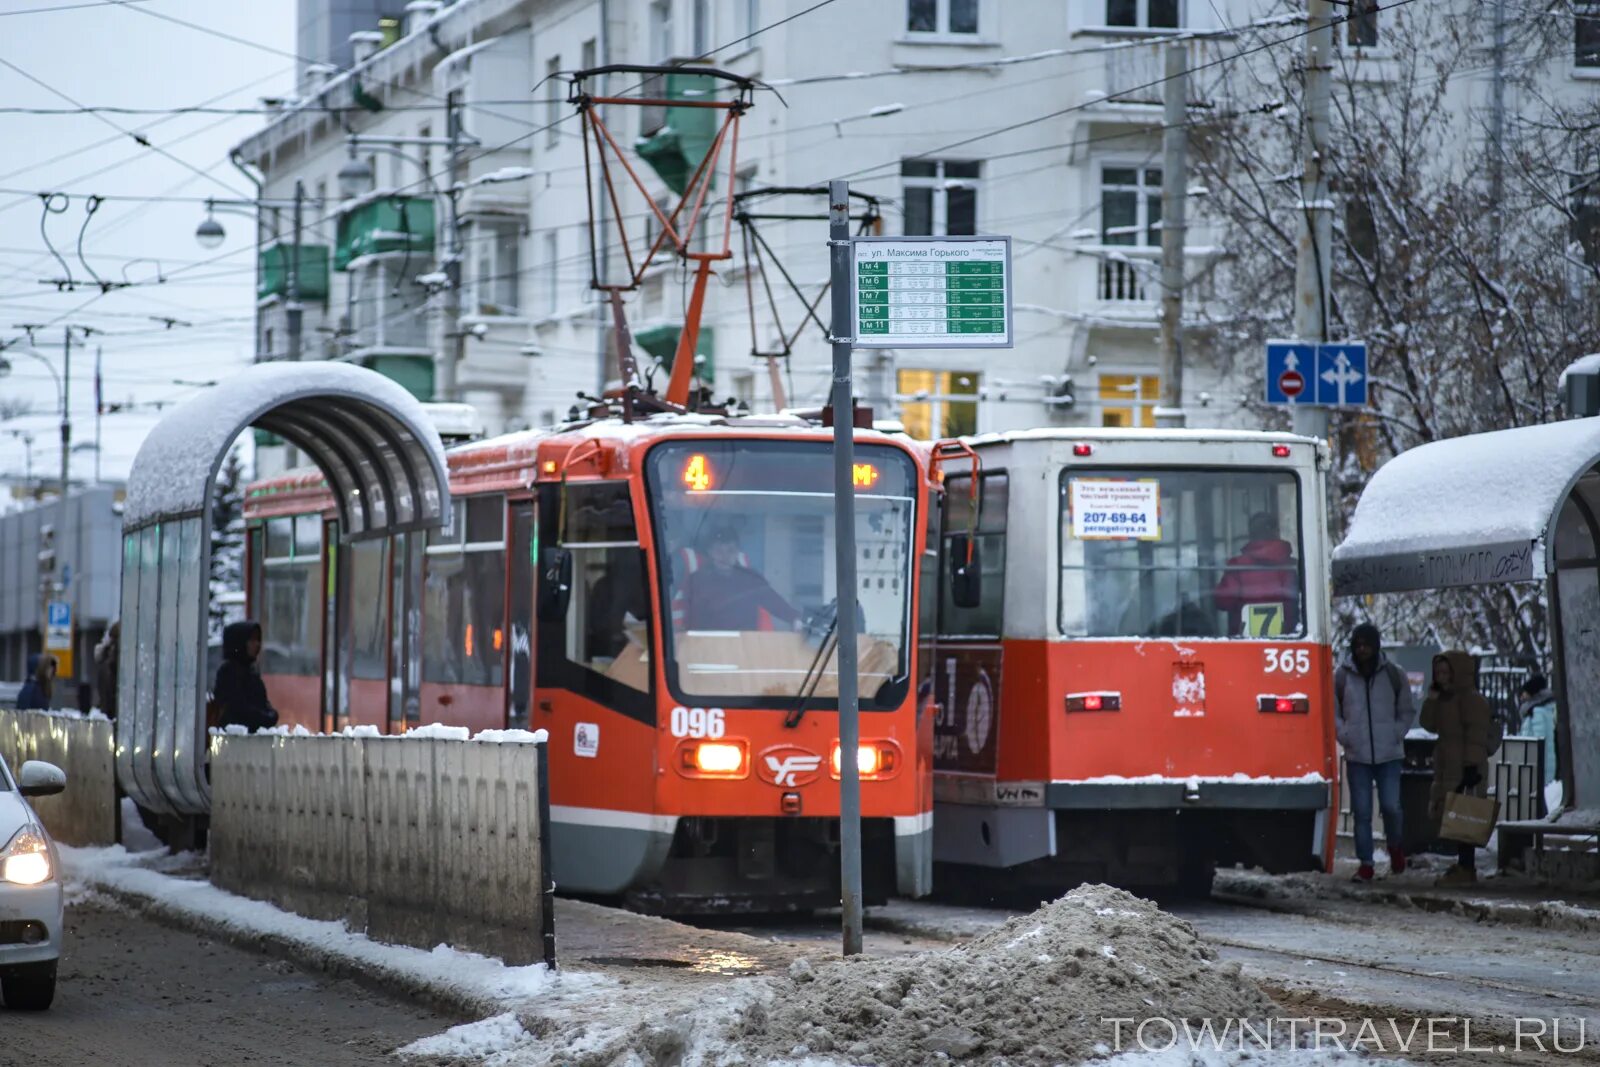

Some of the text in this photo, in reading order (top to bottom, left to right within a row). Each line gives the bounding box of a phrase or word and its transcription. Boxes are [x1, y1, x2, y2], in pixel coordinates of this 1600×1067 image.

[871, 249, 885, 258] ул.
[887, 248, 928, 257] Максима
[930, 248, 969, 258] Горького
[873, 262, 879, 270] 4
[873, 276, 879, 284] 6
[683, 454, 709, 490] 4
[1084, 512, 1146, 523] 207-69-64
[1253, 607, 1278, 637] 7
[1264, 648, 1310, 674] 365
[670, 708, 725, 738] 096
